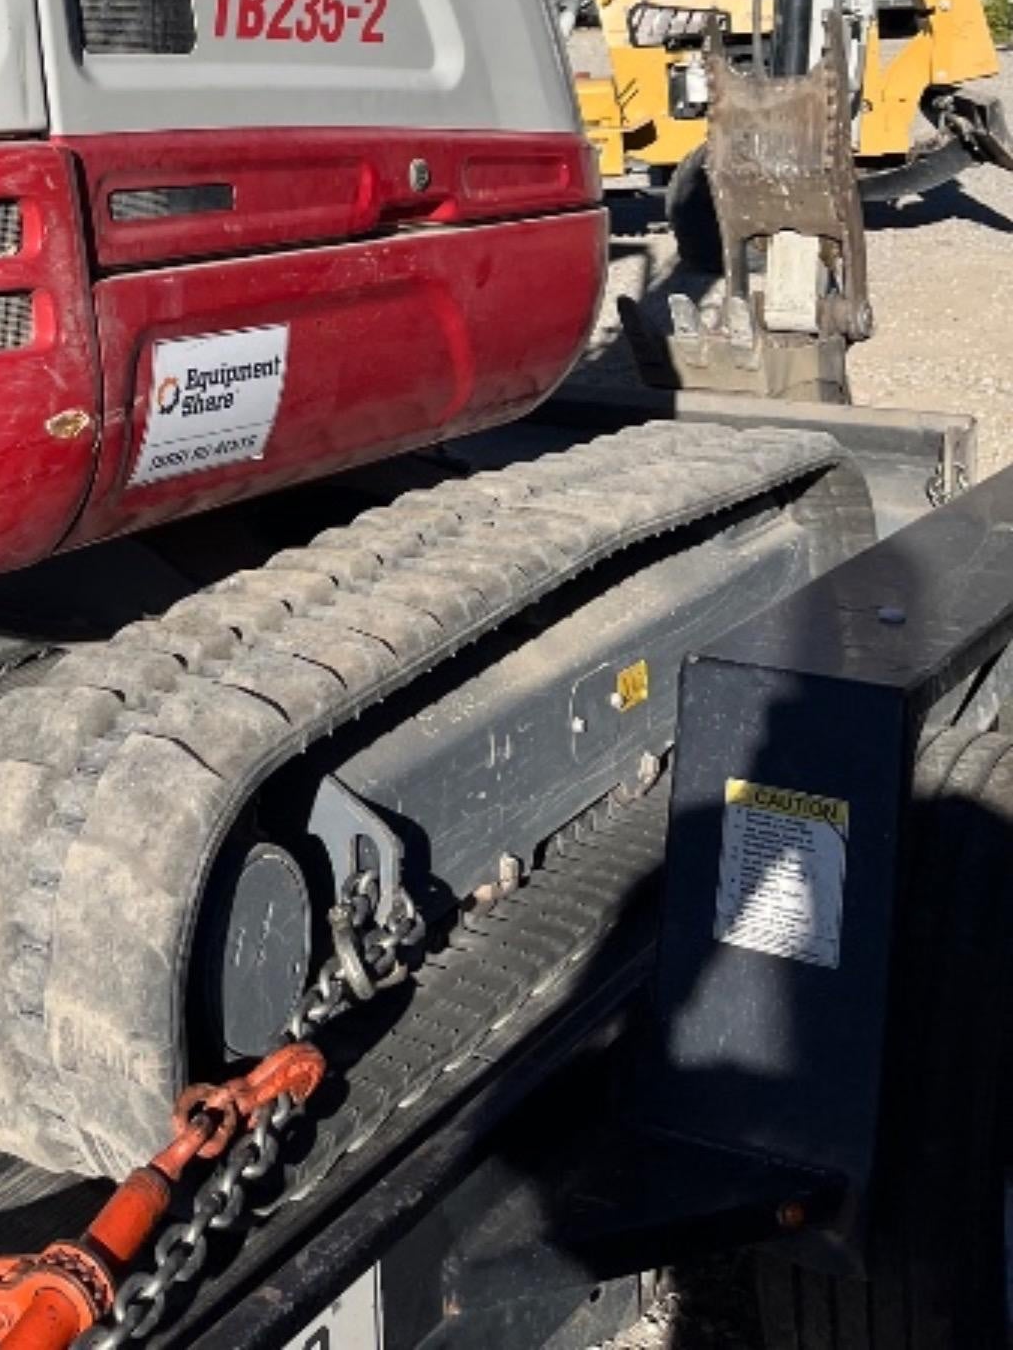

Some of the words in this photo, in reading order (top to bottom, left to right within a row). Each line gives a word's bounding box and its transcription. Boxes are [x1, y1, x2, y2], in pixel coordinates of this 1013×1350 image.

[185, 354, 282, 393] Equipment
[181, 392, 235, 418] Share
[753, 791, 838, 819] CAUTION
